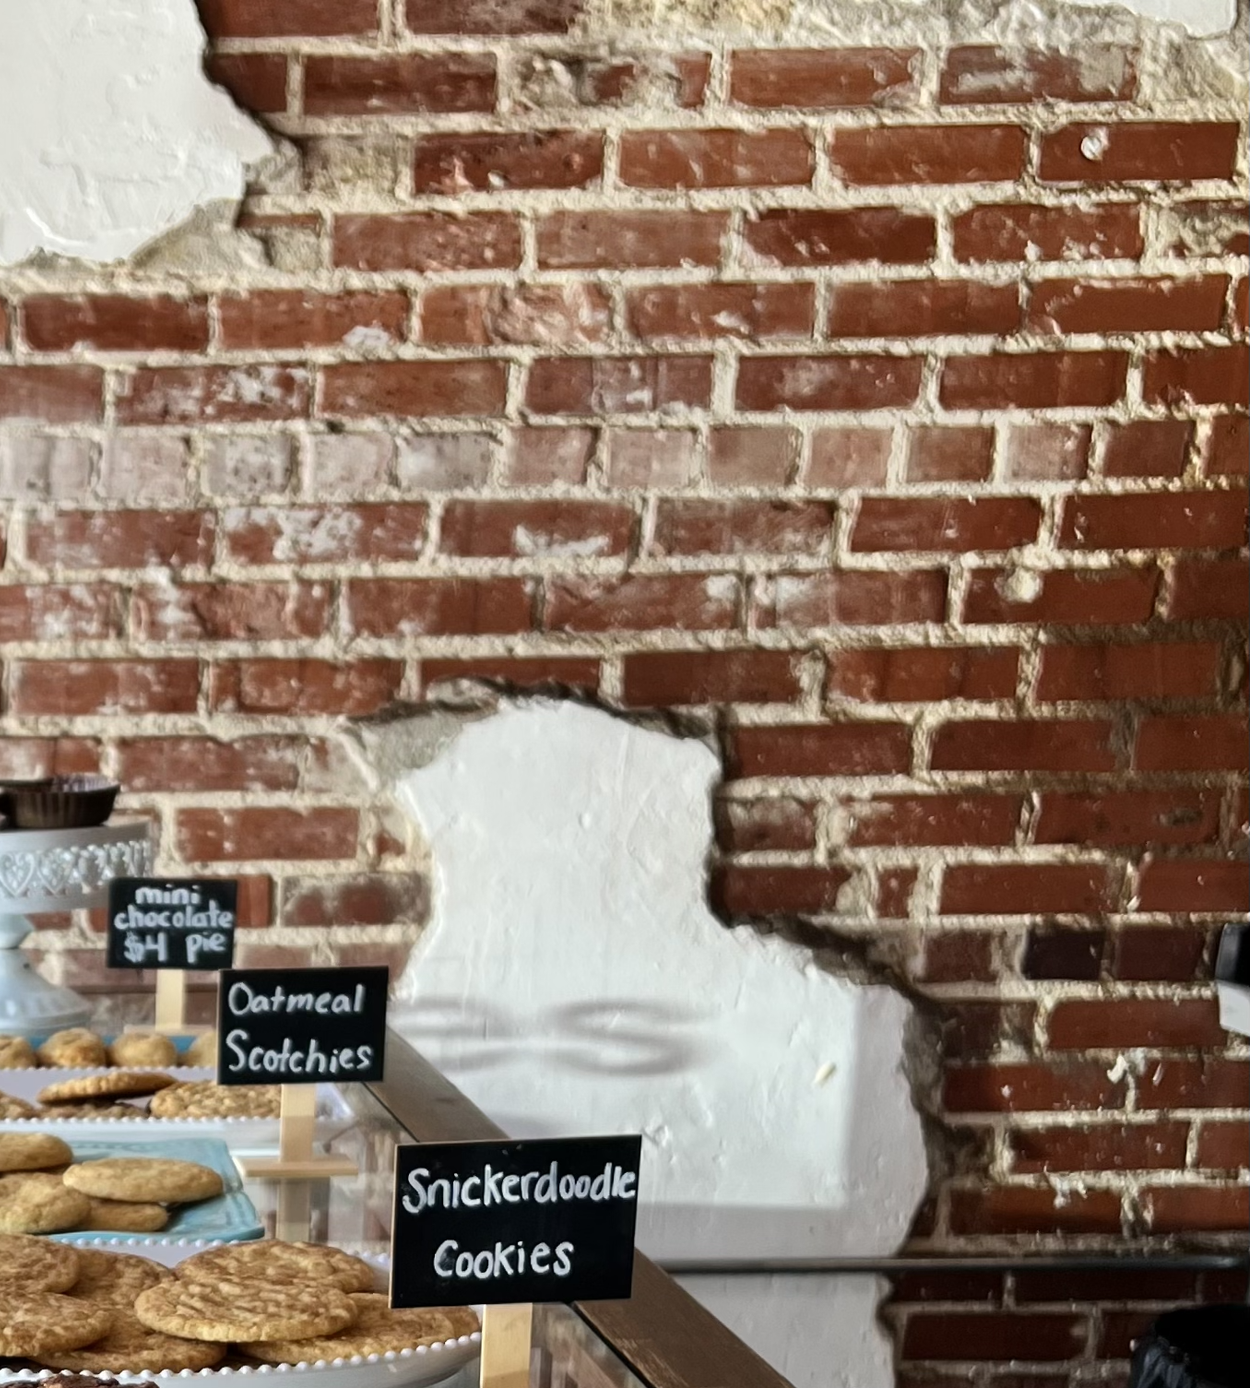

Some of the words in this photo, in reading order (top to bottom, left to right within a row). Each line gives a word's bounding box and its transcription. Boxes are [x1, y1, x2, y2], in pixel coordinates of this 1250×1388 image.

[135, 883, 201, 905] mini
[114, 899, 233, 930] chocolate
[124, 931, 167, 963] $4
[185, 931, 226, 964] pie
[228, 982, 364, 1015] Oatmeal
[226, 1029, 372, 1074] Scotchies
[402, 1160, 636, 1214] Snickerdoodle
[433, 1239, 574, 1279] Cookies
